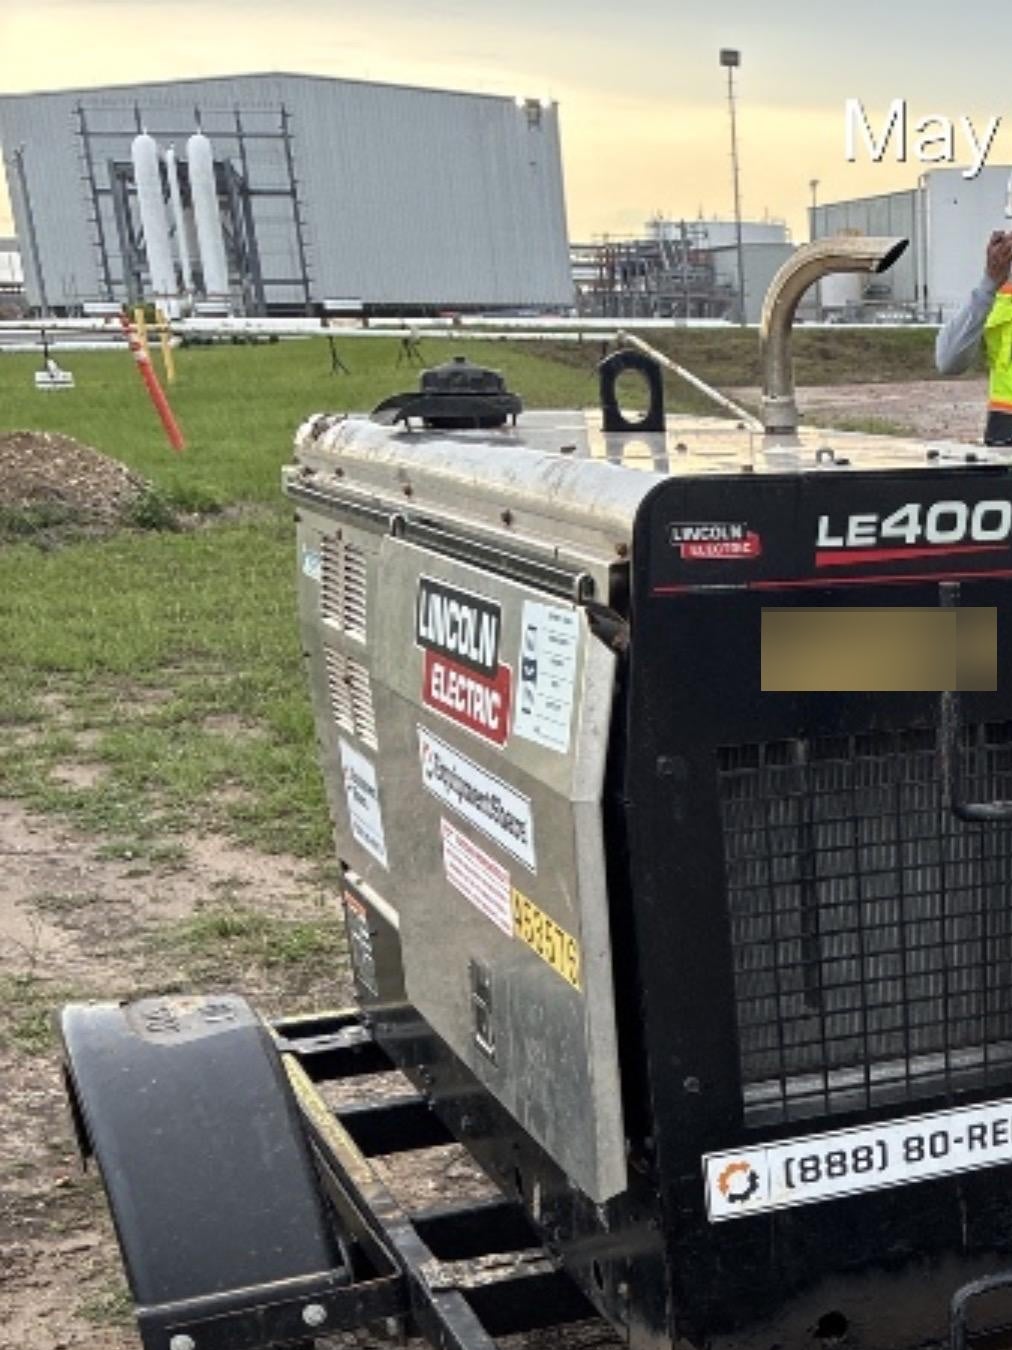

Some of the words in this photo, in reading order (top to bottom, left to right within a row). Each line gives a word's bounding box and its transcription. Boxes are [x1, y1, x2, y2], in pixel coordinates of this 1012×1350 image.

[671, 524, 743, 541] LINCOLN
[816, 500, 1012, 547] LE400
[417, 587, 499, 668] LINCOLN
[430, 661, 501, 730] ELECTRIC
[784, 1139, 889, 1189] (888)
